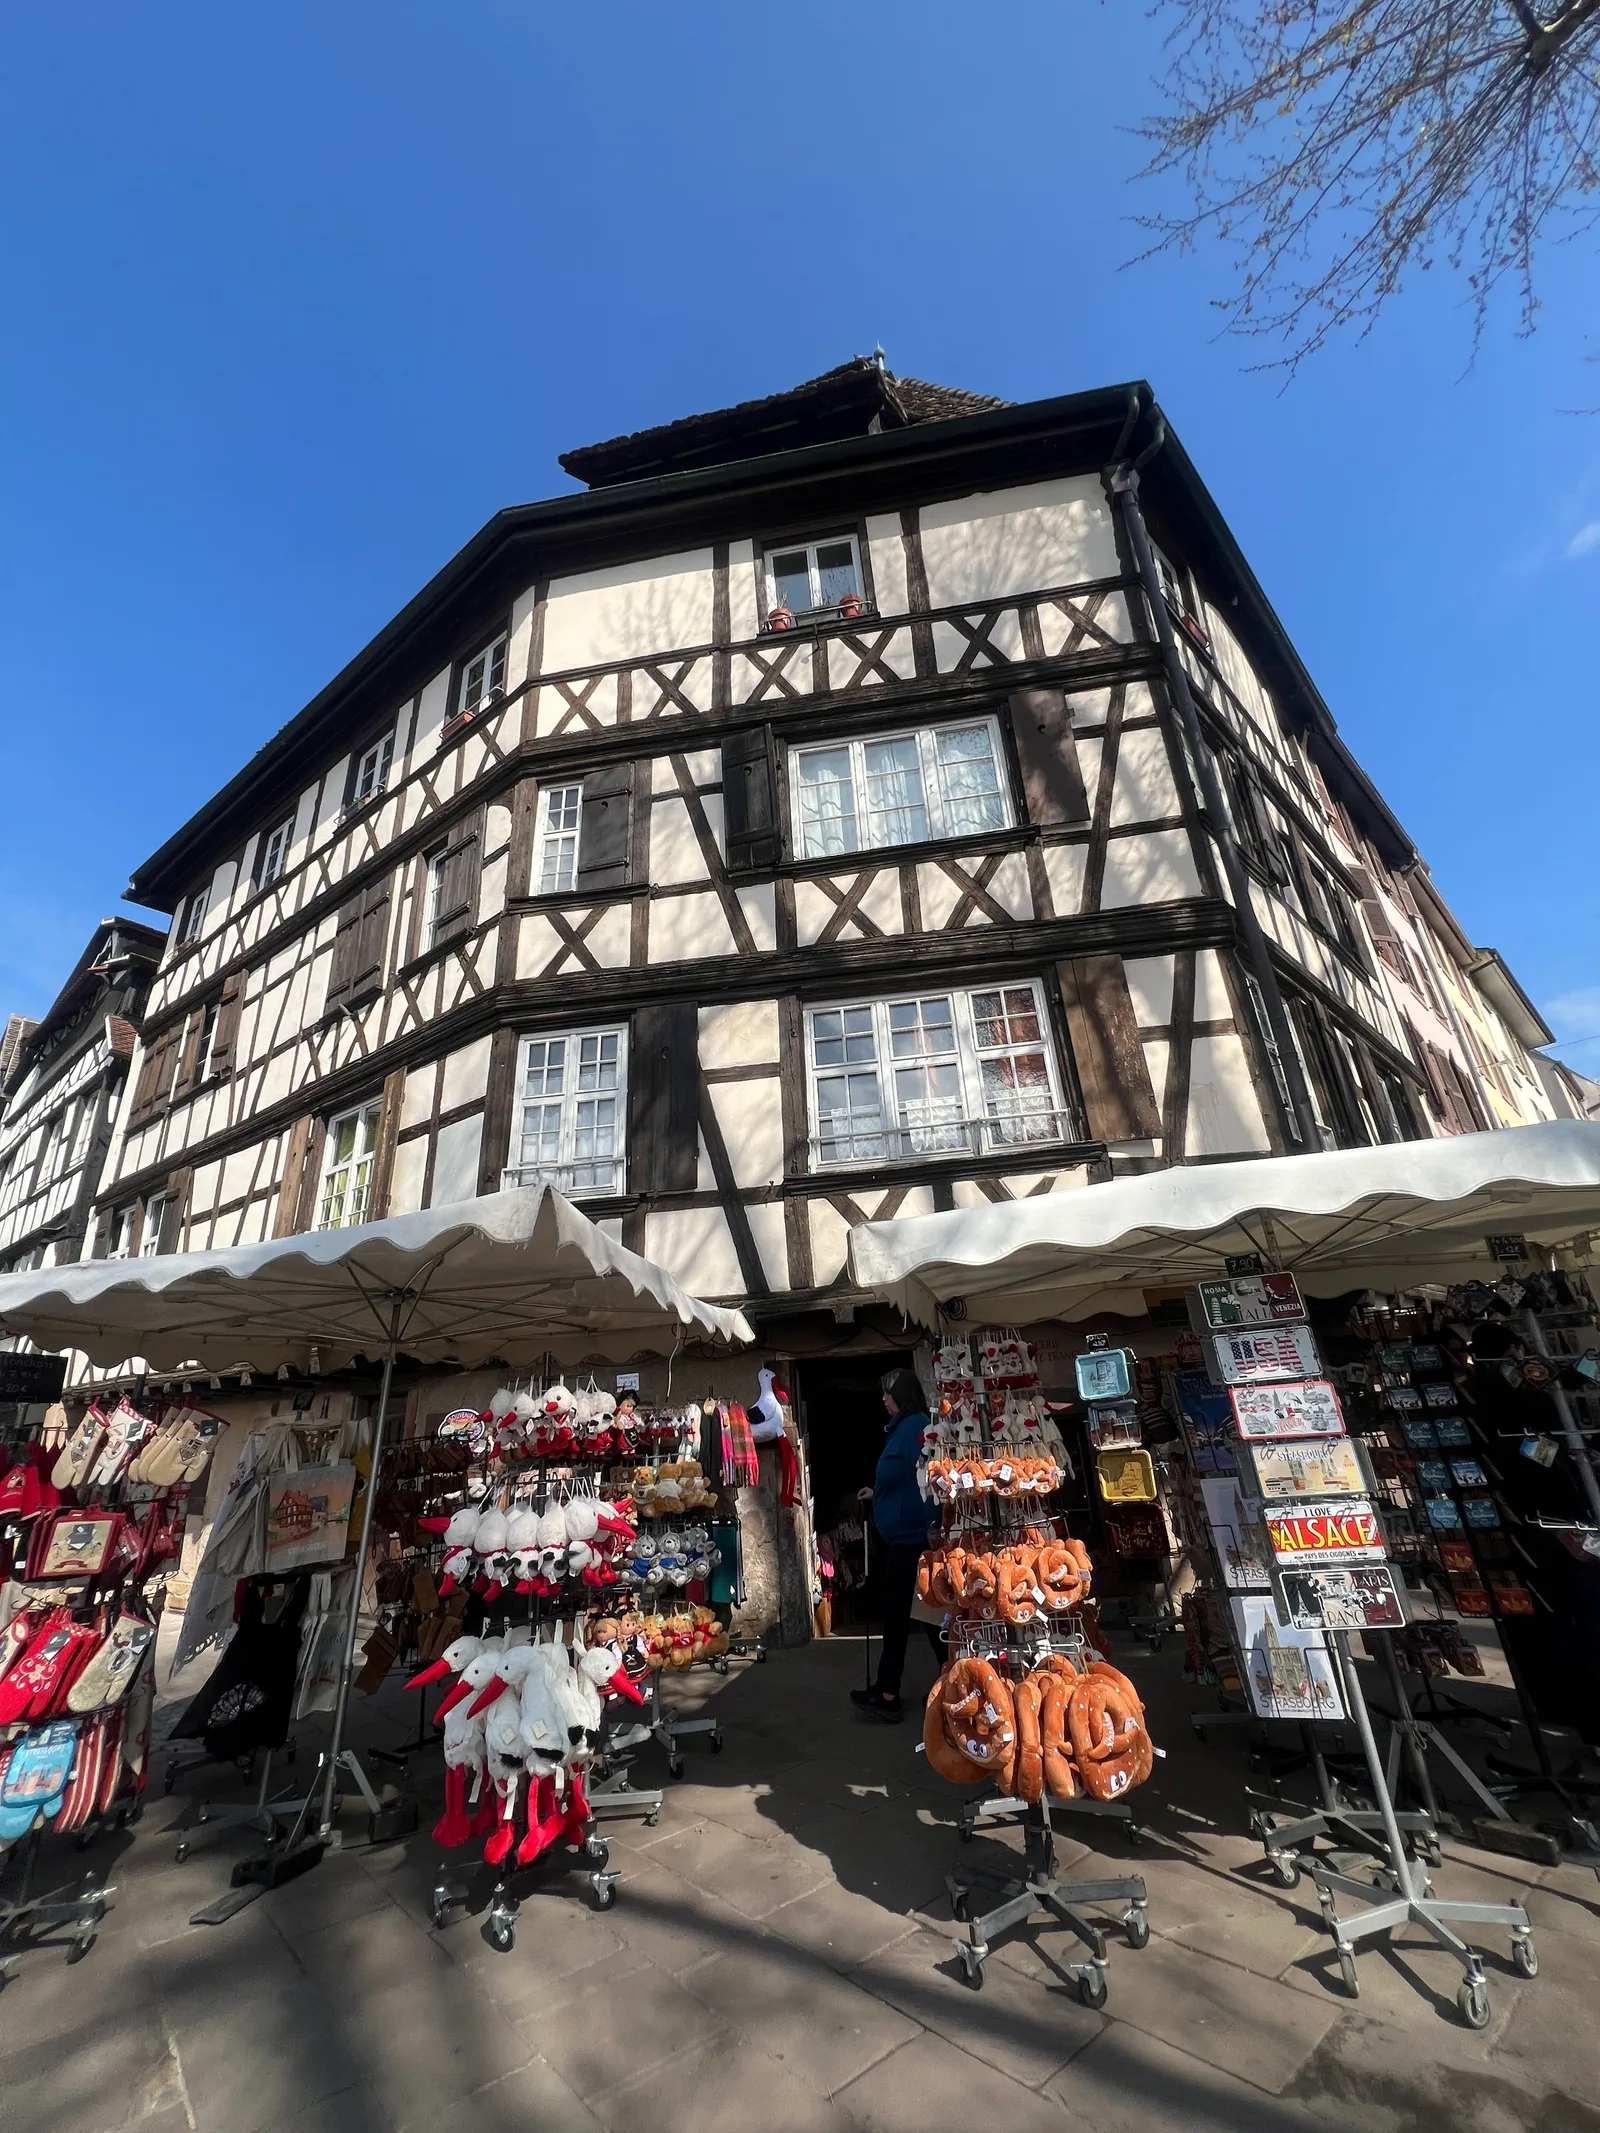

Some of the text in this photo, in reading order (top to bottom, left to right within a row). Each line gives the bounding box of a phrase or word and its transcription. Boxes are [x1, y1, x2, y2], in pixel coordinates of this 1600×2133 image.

[1204, 1286, 1227, 1295] ROMA
[1274, 1302, 1302, 1313] VENEZIA
[1230, 1334, 1305, 1375] USA
[1304, 1507, 1332, 1517] I LOVE
[1280, 1516, 1375, 1551] ALSACE
[1304, 1550, 1357, 1560] PAYS DES CIGOGNES
[1229, 1566, 1270, 1580] STRASB
[1353, 1574, 1389, 1588] PARIS
[1260, 1694, 1336, 1710] STRASBOURG
